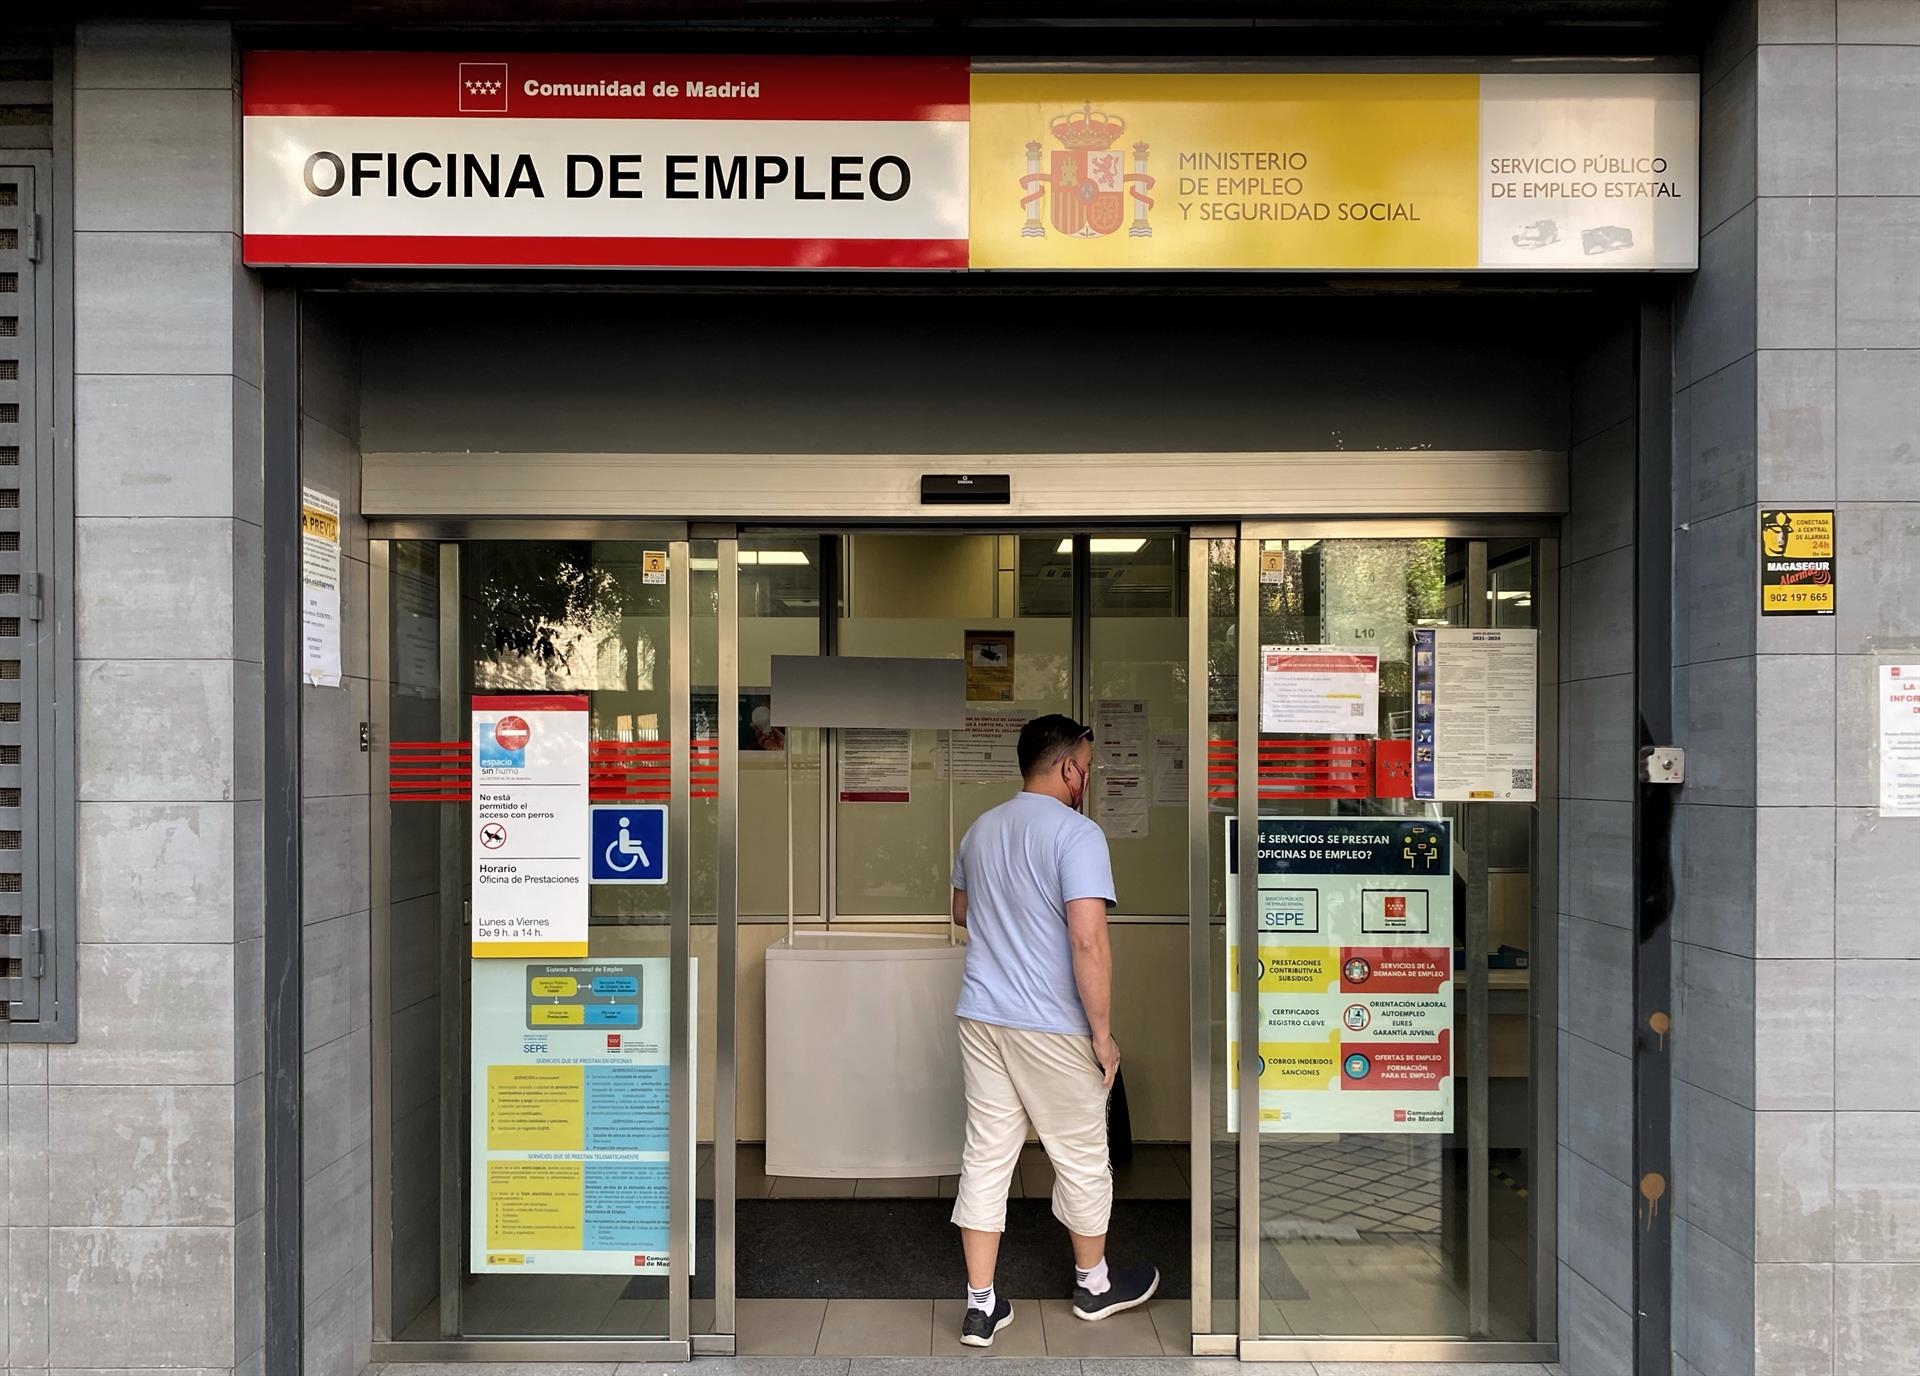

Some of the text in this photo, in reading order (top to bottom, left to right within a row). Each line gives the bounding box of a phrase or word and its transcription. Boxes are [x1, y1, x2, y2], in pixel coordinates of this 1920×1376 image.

[523, 79, 760, 98] Comunidad de Madrid
[1179, 152, 1307, 171] MINISTERIO
[1490, 154, 1668, 174] SERVICIO PÚBLICO
[302, 151, 912, 202] OFICINA DE EMPLEO
[1180, 178, 1303, 196] DE EMPLEO
[1491, 182, 1681, 198] DE EMPLEO ESTATAL
[1179, 203, 1421, 222] Y SEGURIDAD SOCIAL
[310, 517, 336, 538] PREVIA
[1812, 541, 1830, 549] 24h
[1767, 562, 1830, 571] MAGASEGUR
[1780, 569, 1818, 586] Alarmas
[1770, 593, 1828, 602] 902 197 665
[1354, 628, 1375, 639] L10
[1904, 683, 1916, 691] LA
[1890, 695, 1920, 703] INFOR
[481, 758, 512, 767] espacio
[493, 793, 511, 801] está
[480, 802, 528, 811] permitido el
[528, 812, 554, 820] perros
[1268, 835, 1324, 844] SERVICIOS
[1327, 835, 1339, 844] SE
[1342, 836, 1390, 845] PRESTAN
[1258, 849, 1373, 860] OFICINAS DE EMPLEO?
[480, 864, 517, 873] Horario
[480, 875, 579, 884] Oficina de Prestaciones
[479, 917, 550, 927] Lunes a Viernes
[1265, 913, 1304, 926] SEPE
[479, 928, 543, 938] De 9 h. a 14 h.
[1370, 1000, 1416, 1008] ORIENTACIÓN
[1373, 1028, 1408, 1036] GARANTÍA
[523, 1044, 548, 1054] SEPE
[1387, 1063, 1428, 1071] FORMACIÓN
